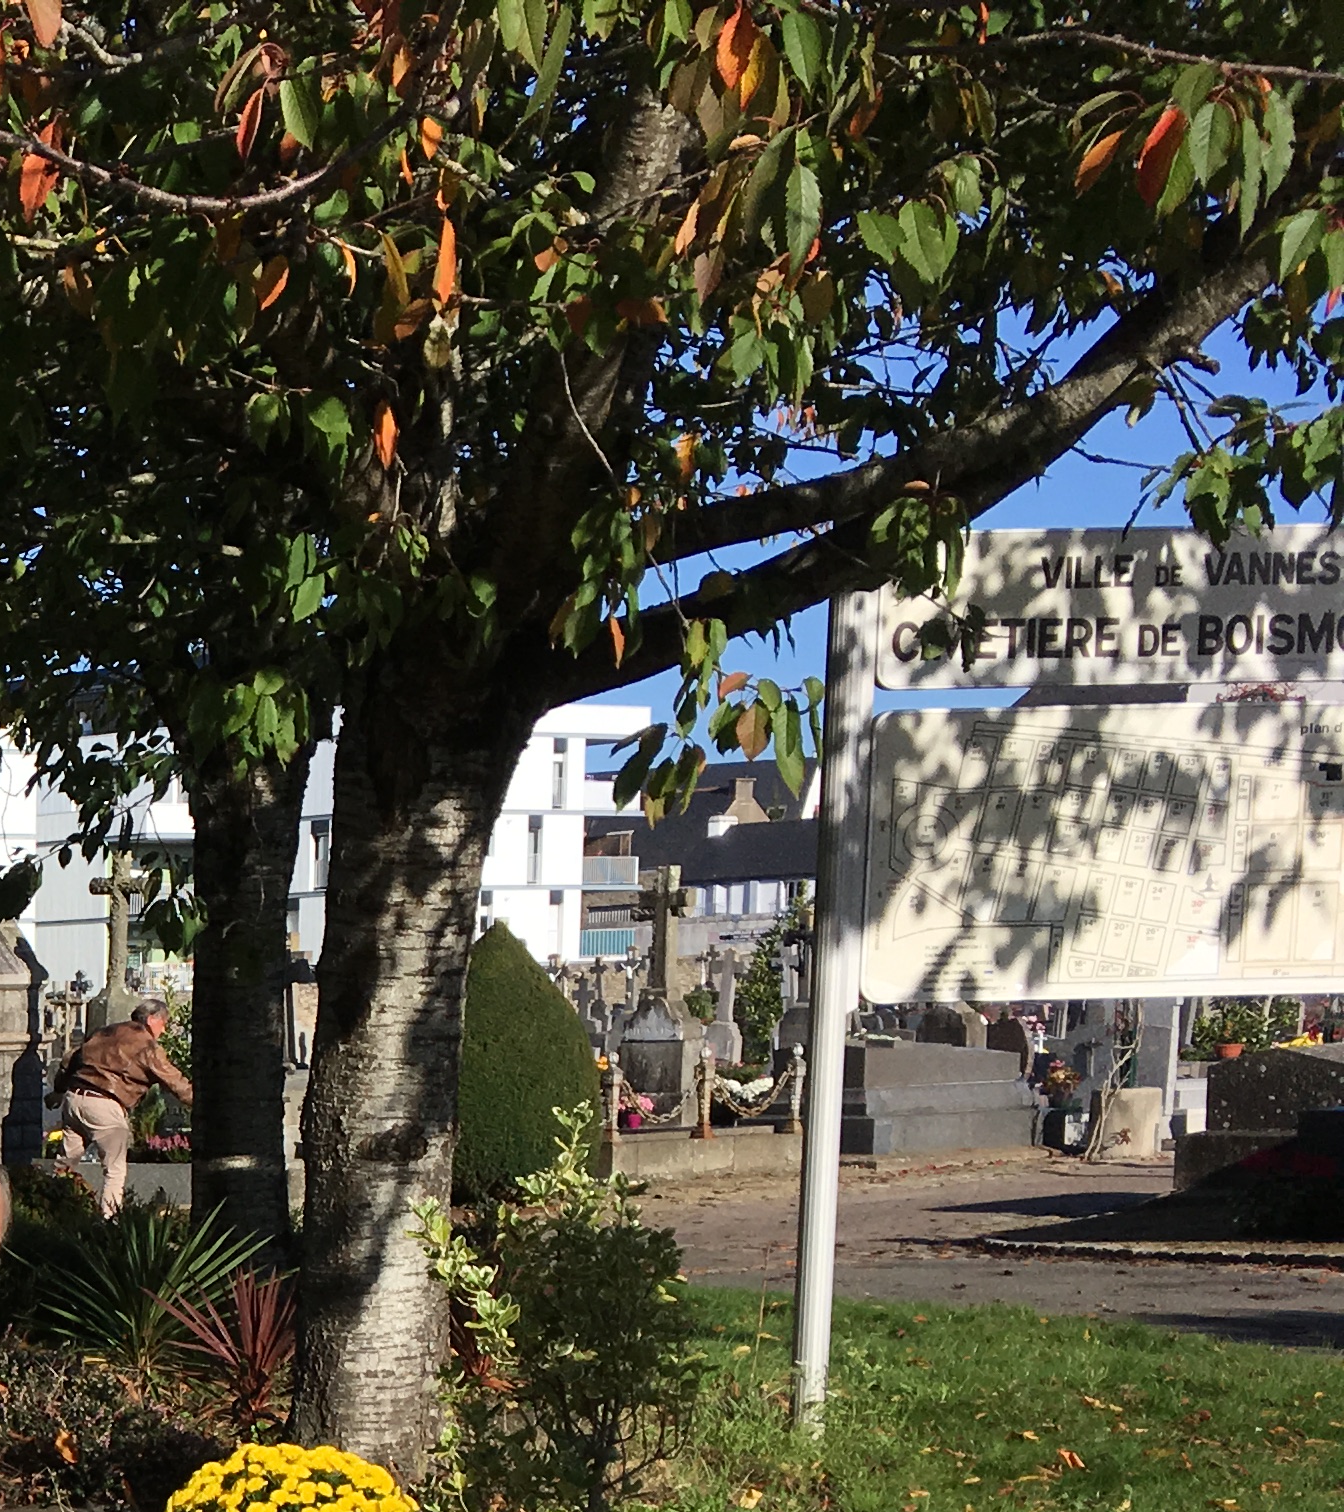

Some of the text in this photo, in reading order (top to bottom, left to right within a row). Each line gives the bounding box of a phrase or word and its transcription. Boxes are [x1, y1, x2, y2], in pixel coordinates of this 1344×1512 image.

[1041, 551, 1344, 589] VILLE DE VANNES
[892, 613, 1344, 662] CETIERE DE BOISM
[1300, 722, 1329, 736] plan
